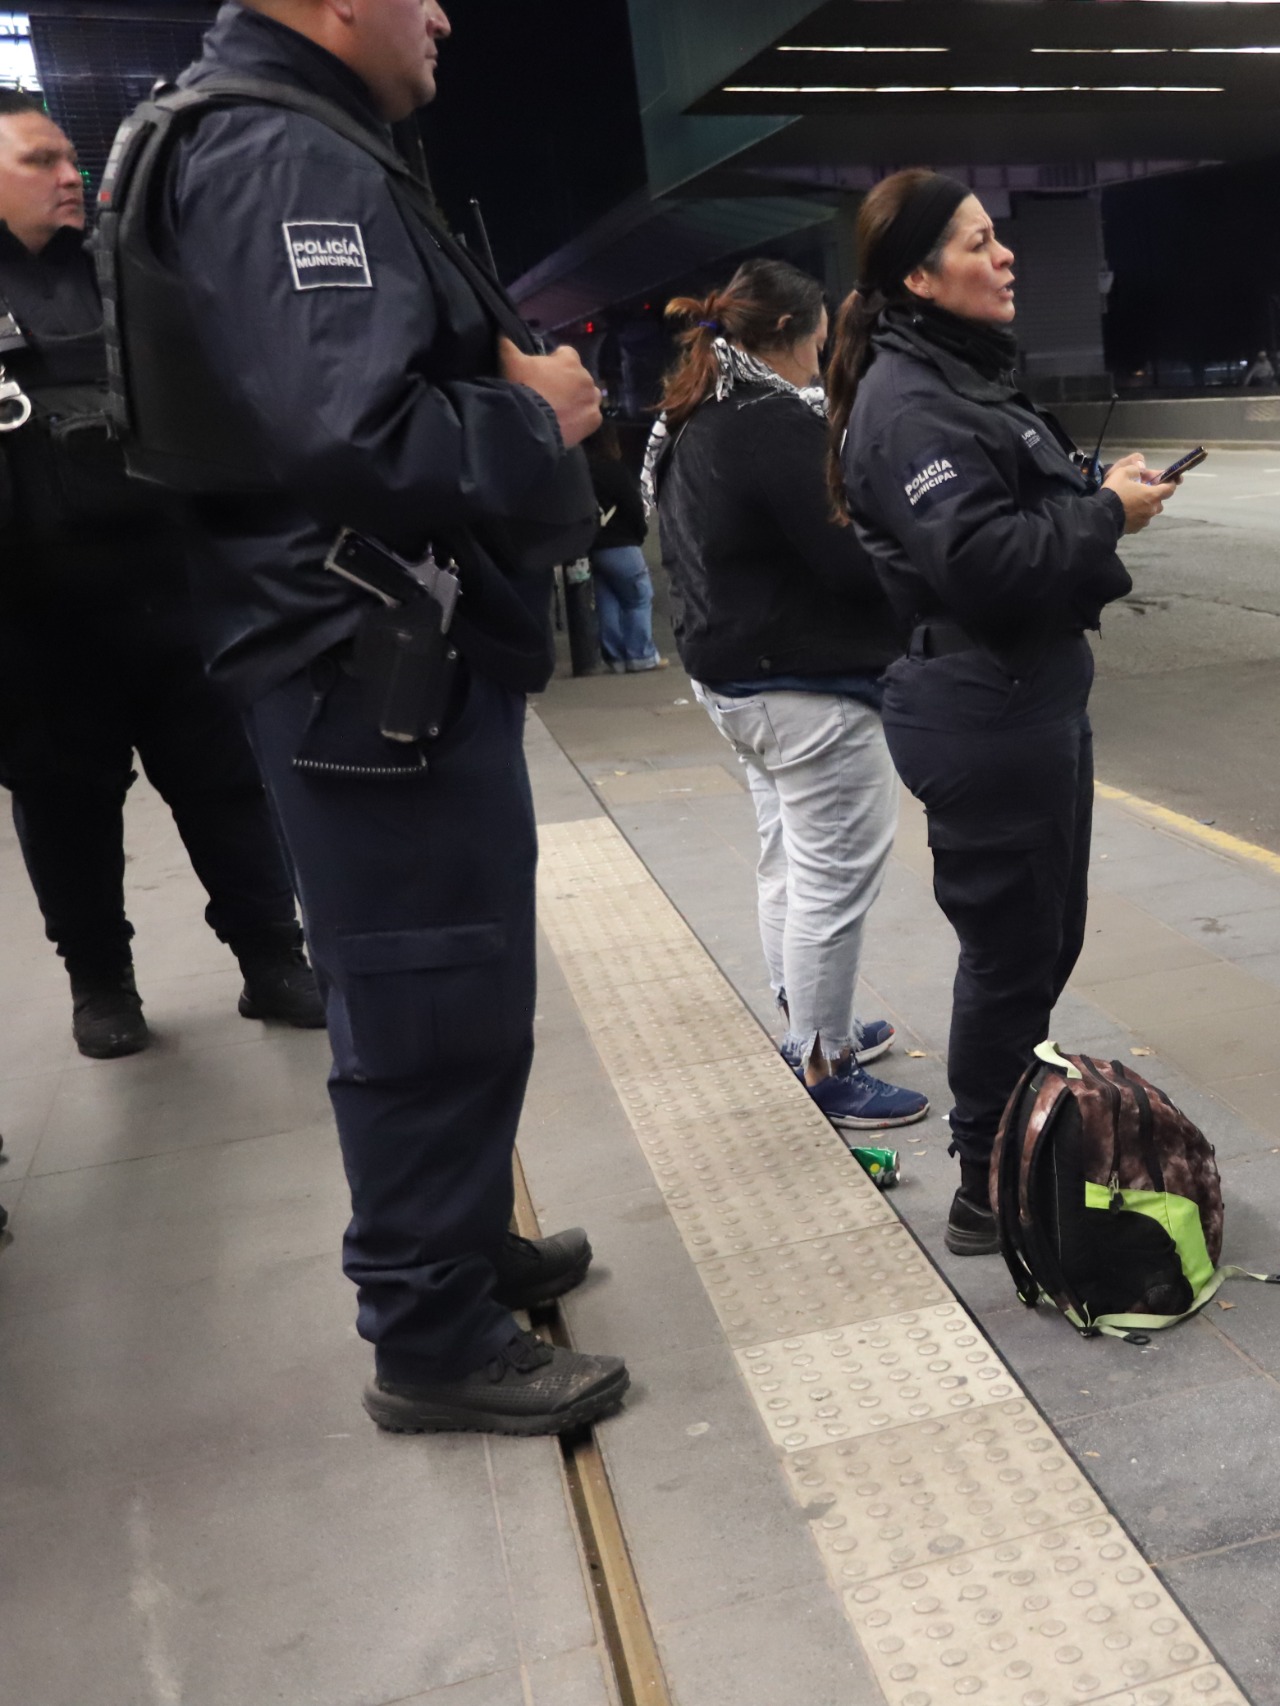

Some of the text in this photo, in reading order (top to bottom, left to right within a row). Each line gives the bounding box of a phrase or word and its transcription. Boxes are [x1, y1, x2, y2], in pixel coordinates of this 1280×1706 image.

[293, 238, 360, 256] POLICÍA
[296, 255, 363, 268] MUNICIPAL
[904, 459, 952, 496] POLICÍA
[909, 470, 957, 506] MUNICIPAL
